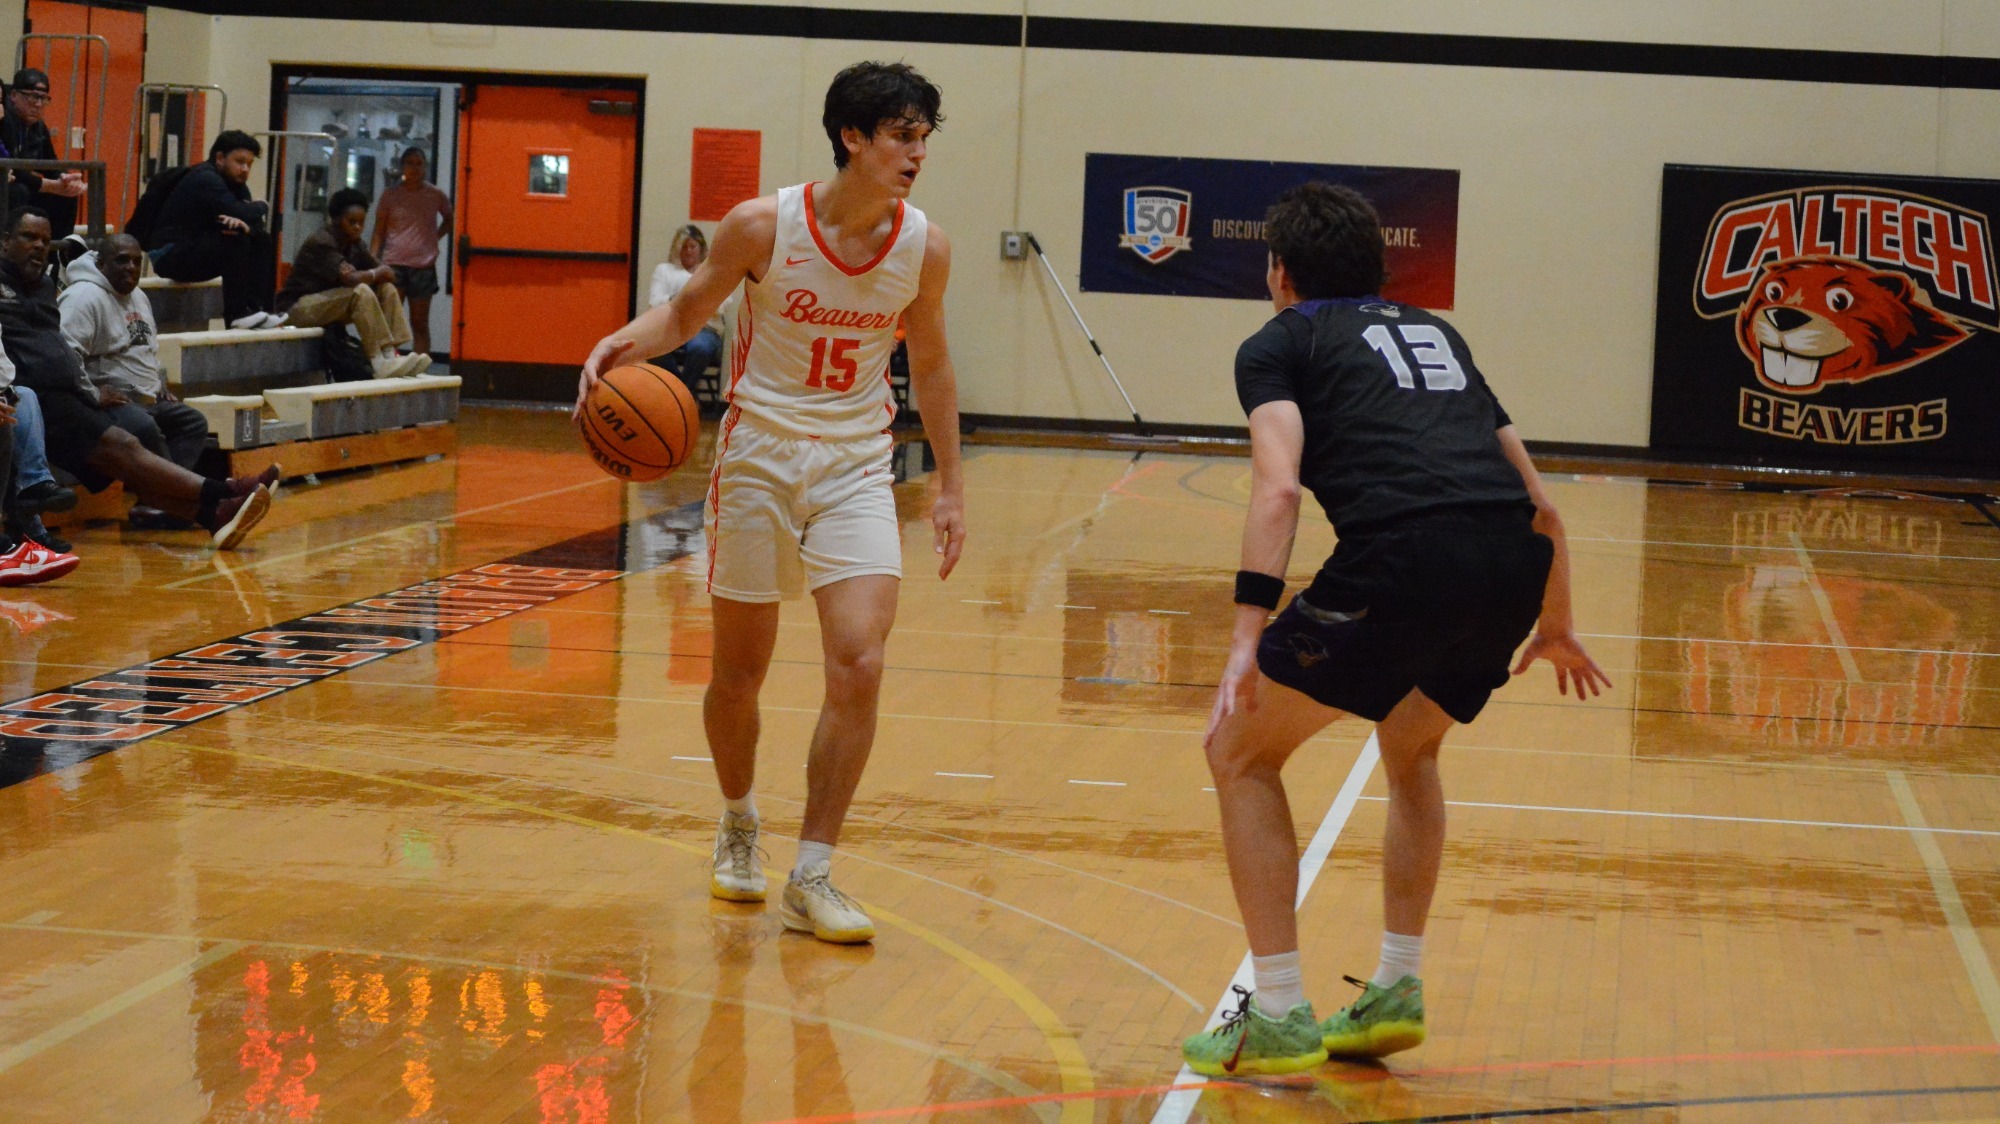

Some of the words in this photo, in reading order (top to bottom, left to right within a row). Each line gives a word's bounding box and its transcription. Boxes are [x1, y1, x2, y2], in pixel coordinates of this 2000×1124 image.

[1137, 205, 1177, 233] 50
[1212, 218, 1268, 240] DISCOVE
[1702, 194, 1996, 311] CALTECH
[778, 288, 896, 329] Beavers
[805, 336, 861, 392] 15
[1361, 324, 1468, 391] 13
[597, 404, 638, 442] EVO
[1739, 386, 1948, 445] BEAVERS
